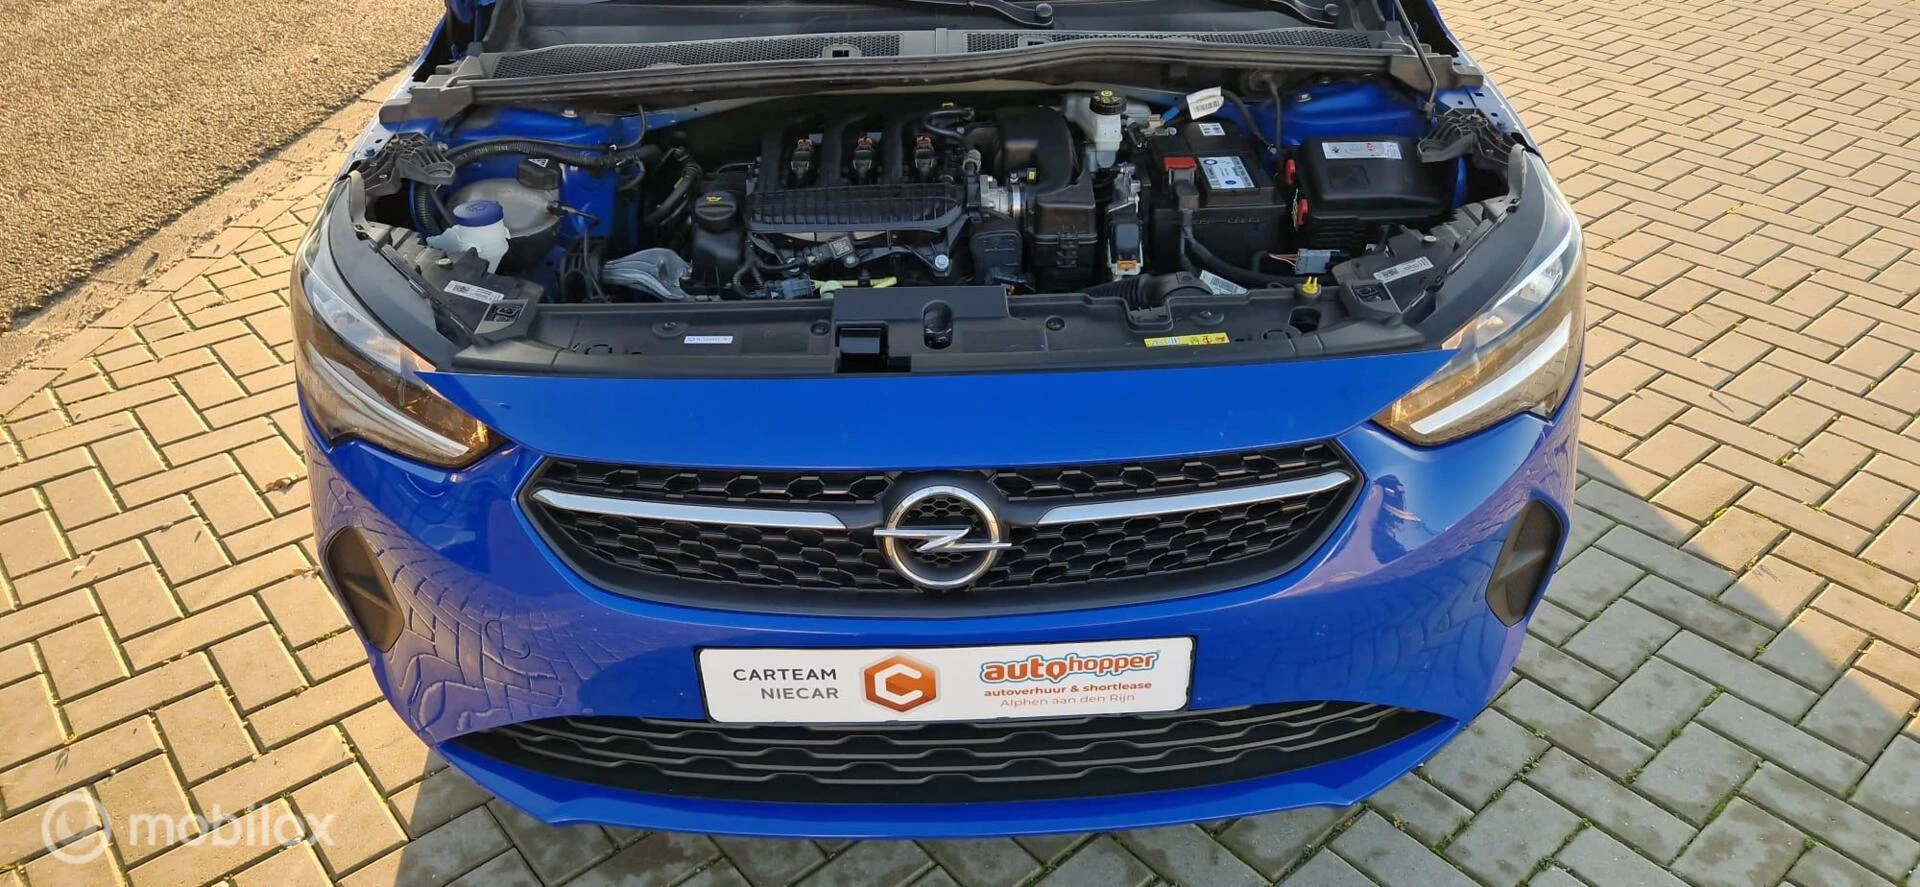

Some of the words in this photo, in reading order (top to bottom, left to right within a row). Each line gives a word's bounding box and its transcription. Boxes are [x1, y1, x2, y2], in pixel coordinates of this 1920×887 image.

[733, 668, 837, 681] CARTEAM
[982, 653, 1156, 681] autohopper
[761, 687, 839, 700] NIECAR
[984, 685, 1066, 697] autoverhuur
[1070, 685, 1079, 693] &
[1082, 681, 1152, 692] shortlease
[1000, 697, 1048, 708] Alphen
[1052, 696, 1075, 705] aan
[1080, 694, 1106, 704] den
[1110, 693, 1135, 704] Rijn
